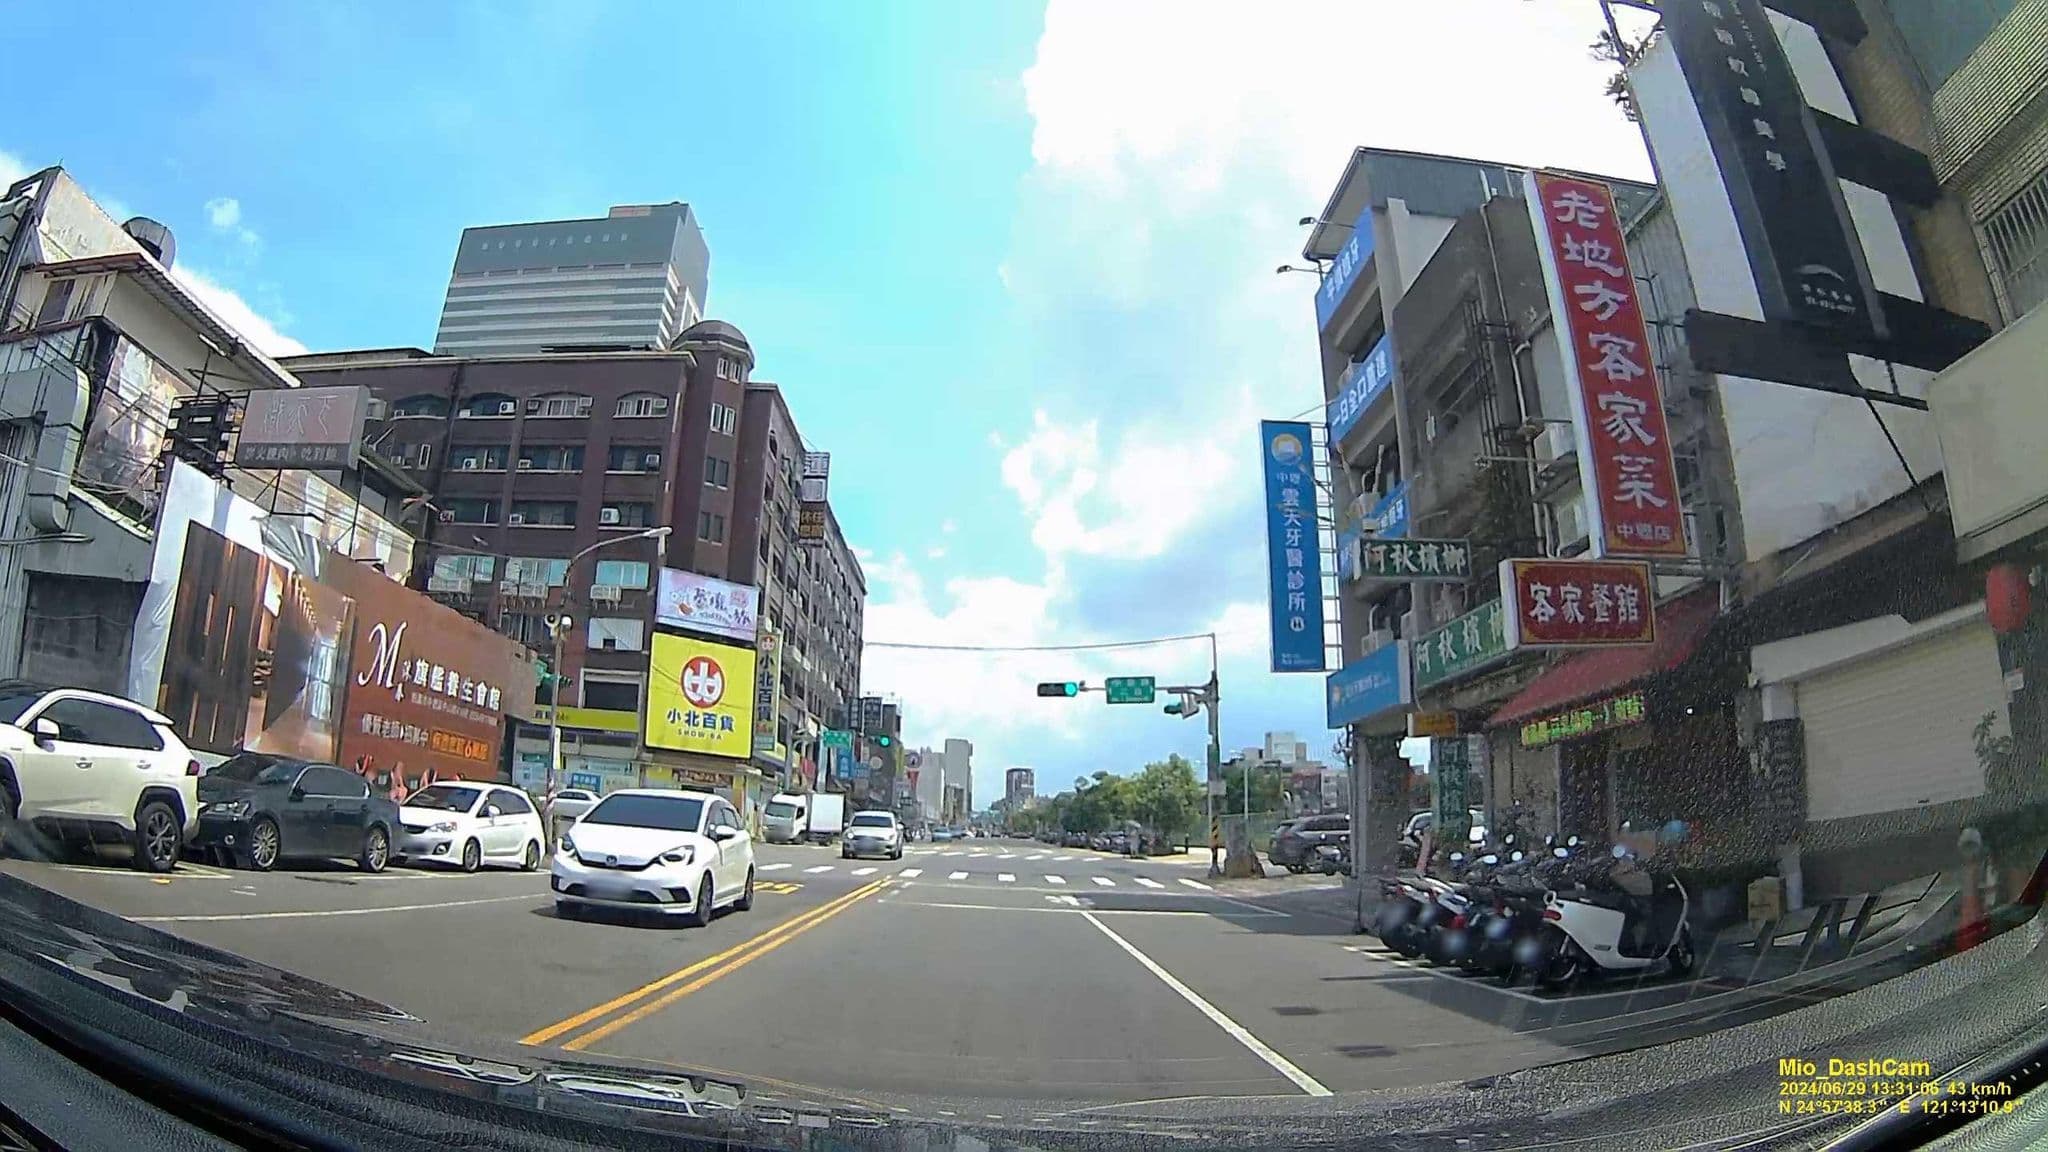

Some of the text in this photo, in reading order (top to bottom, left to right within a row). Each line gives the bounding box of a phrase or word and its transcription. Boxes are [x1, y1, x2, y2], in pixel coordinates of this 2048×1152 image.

[1553, 190, 1667, 509] 老地方客家菜
[1282, 487, 1306, 613] 雲天牙醫診所
[1364, 542, 1467, 575] 阿秋檳榔
[413, 657, 501, 712] 旗艦養生會館
[758, 653, 774, 722] 小北百貨
[667, 708, 734, 732] 小北百貨
